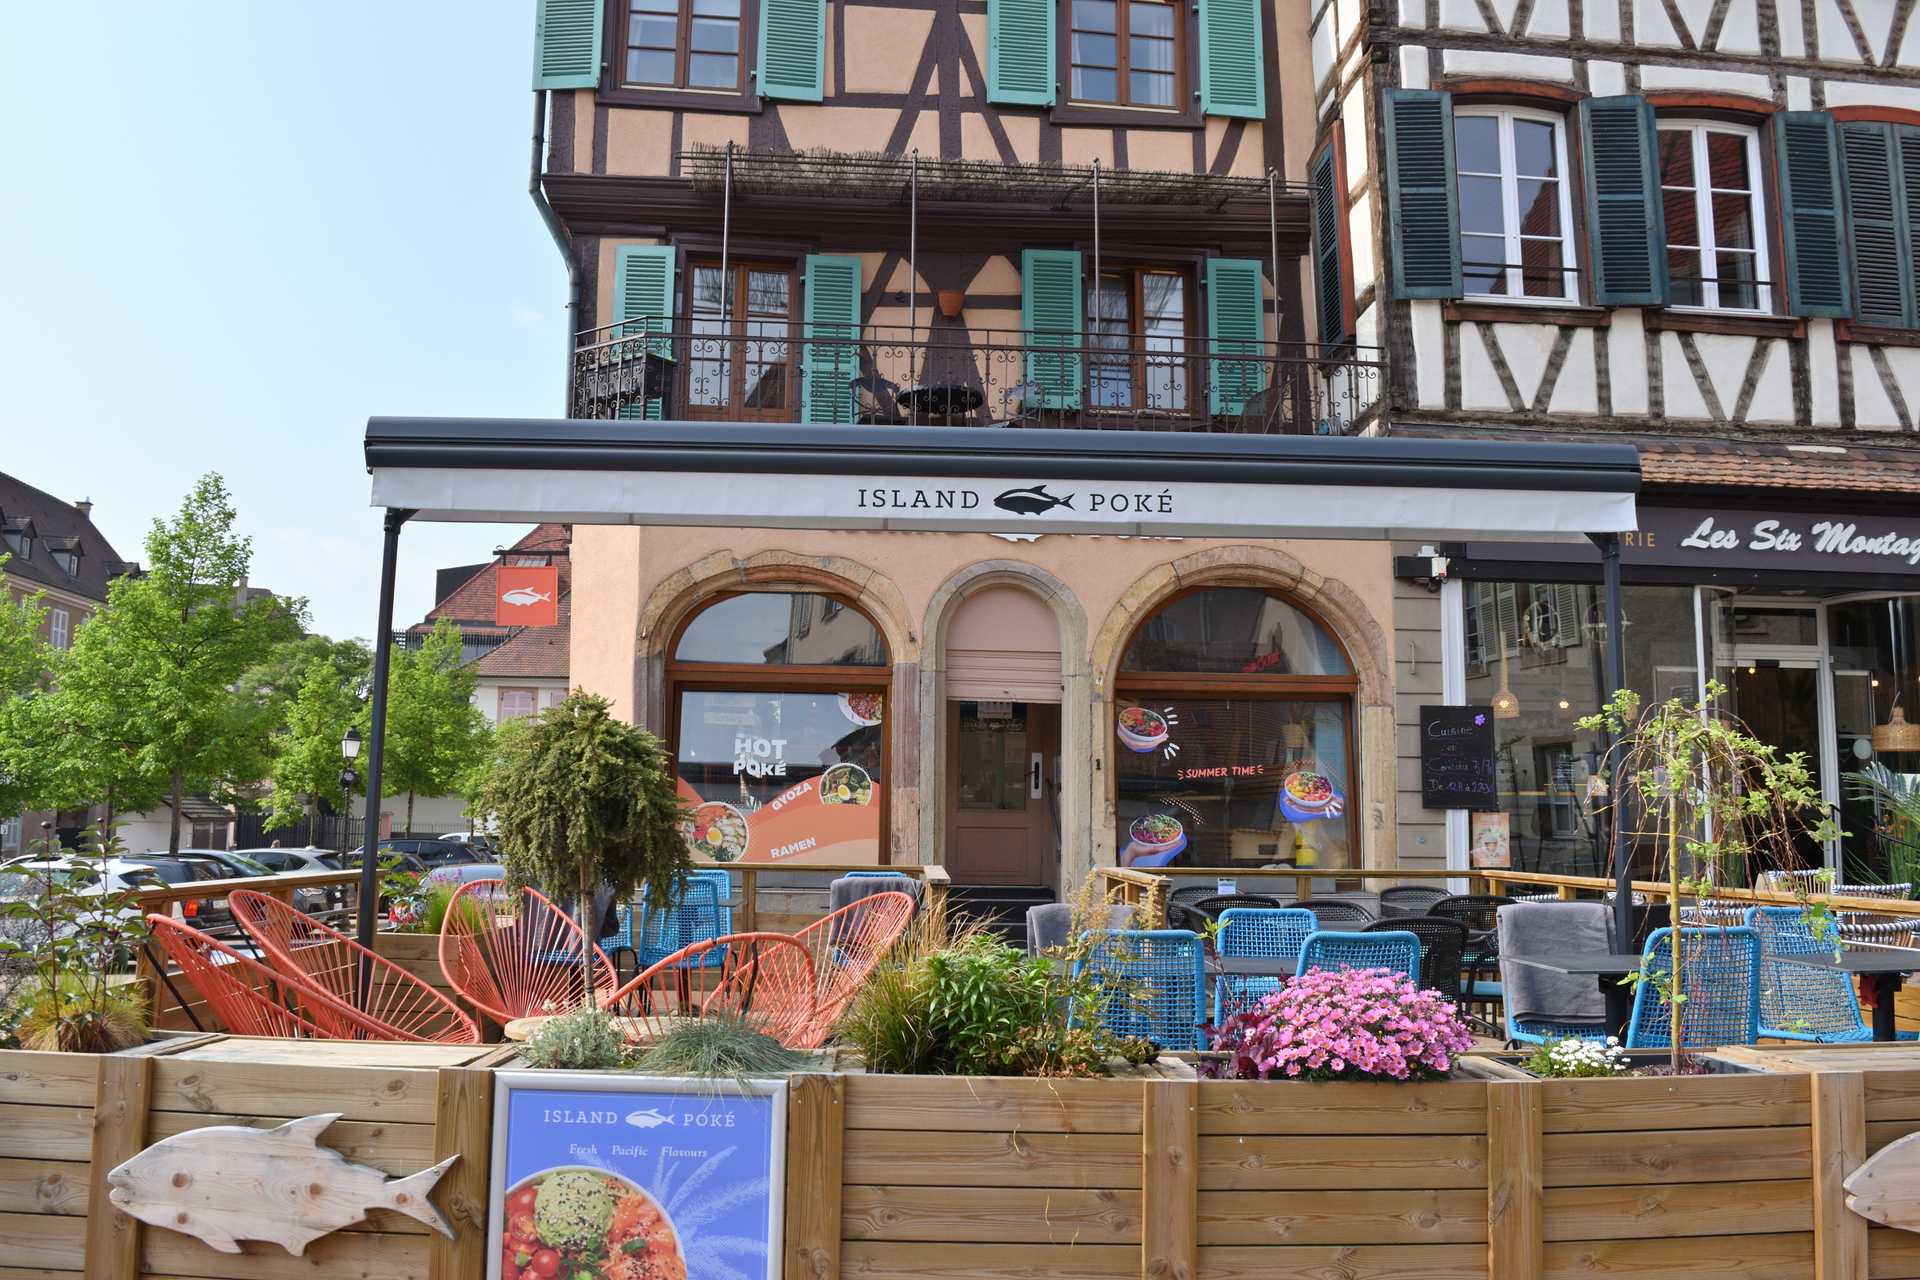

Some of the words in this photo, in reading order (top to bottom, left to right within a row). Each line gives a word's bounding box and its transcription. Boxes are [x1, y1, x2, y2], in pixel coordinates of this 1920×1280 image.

[858, 489, 979, 509] ISLAND
[1089, 489, 1173, 513] POKÉ
[1681, 517, 1739, 549] Les
[1750, 520, 1801, 551] Six
[1428, 720, 1473, 737] Cuisine
[734, 738, 787, 759] HOT
[733, 759, 787, 777] POKÉ
[1186, 767, 1228, 778] SUMMER
[1232, 765, 1256, 776] TIME
[771, 782, 813, 811] GYOZA
[770, 837, 816, 858] RAMEN
[544, 1109, 618, 1124] ISLAND
[683, 1111, 735, 1128] POKÉ
[569, 1143, 597, 1155] Fresh
[611, 1145, 648, 1158] Pacific
[661, 1145, 707, 1158] Flavours
